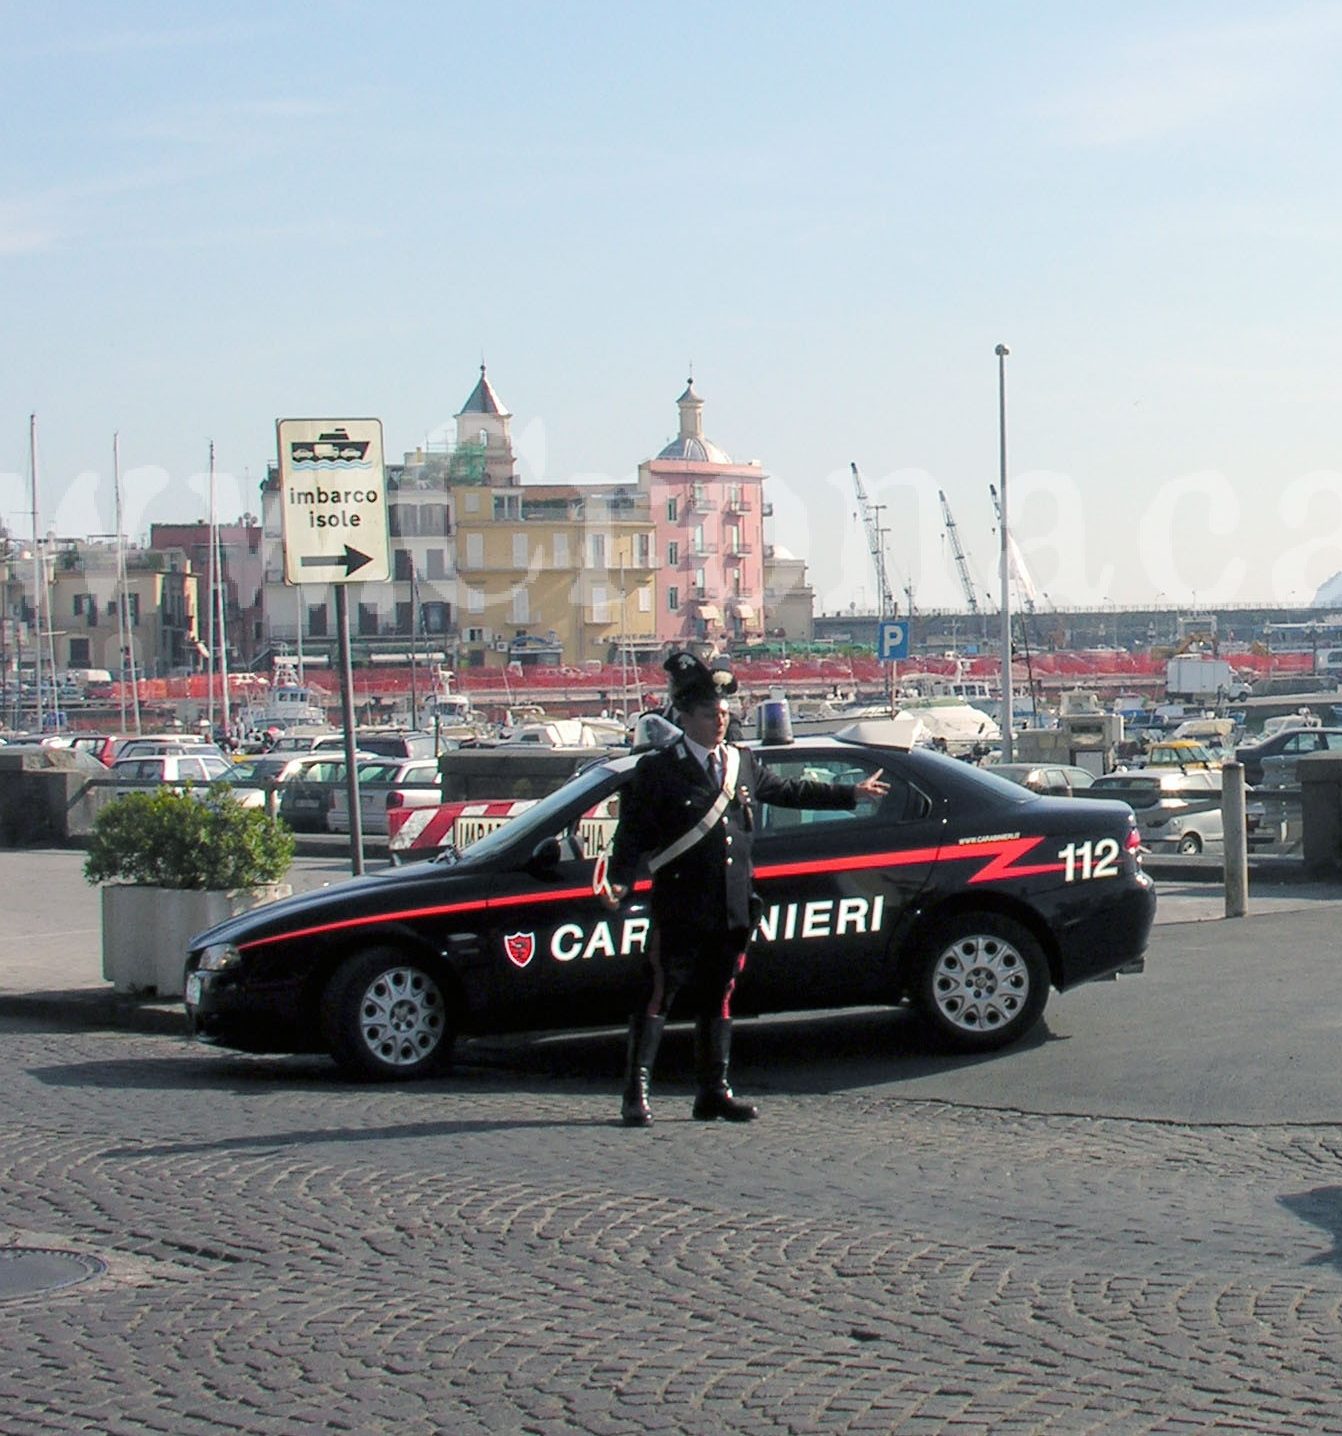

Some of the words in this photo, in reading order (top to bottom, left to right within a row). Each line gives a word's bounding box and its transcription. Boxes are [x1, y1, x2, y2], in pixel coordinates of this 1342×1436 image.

[290, 487, 378, 504] imbarco
[309, 511, 361, 528] isole
[884, 625, 904, 657] P
[1058, 838, 1119, 882] 112
[550, 895, 884, 962] CARNIERI
